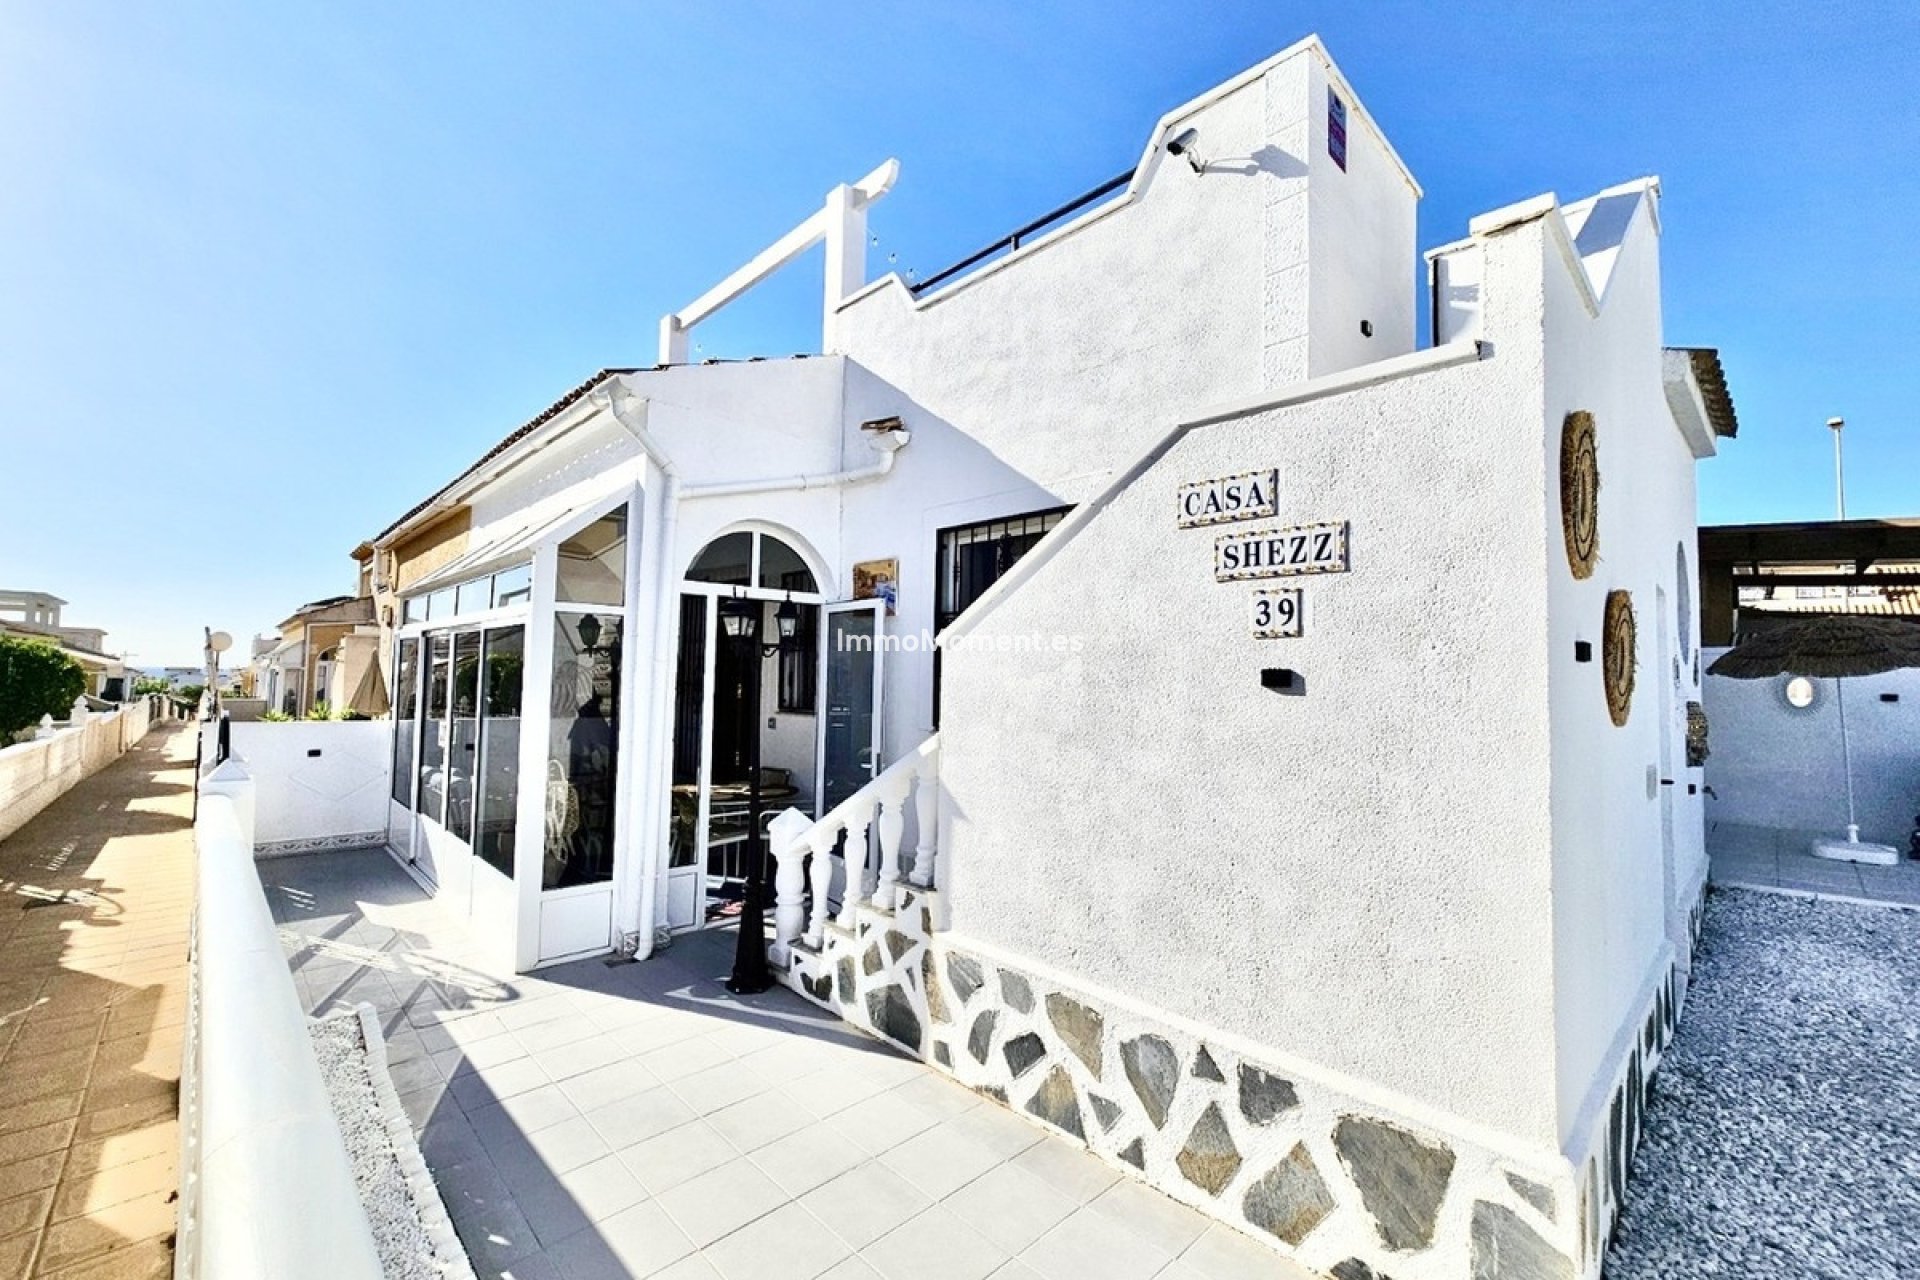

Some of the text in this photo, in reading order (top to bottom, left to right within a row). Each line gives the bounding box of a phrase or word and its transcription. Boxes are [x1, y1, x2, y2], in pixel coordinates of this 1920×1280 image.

[1185, 481, 1265, 517] CASA
[1223, 533, 1332, 570] SHEZZ
[1255, 598, 1295, 627] 39
